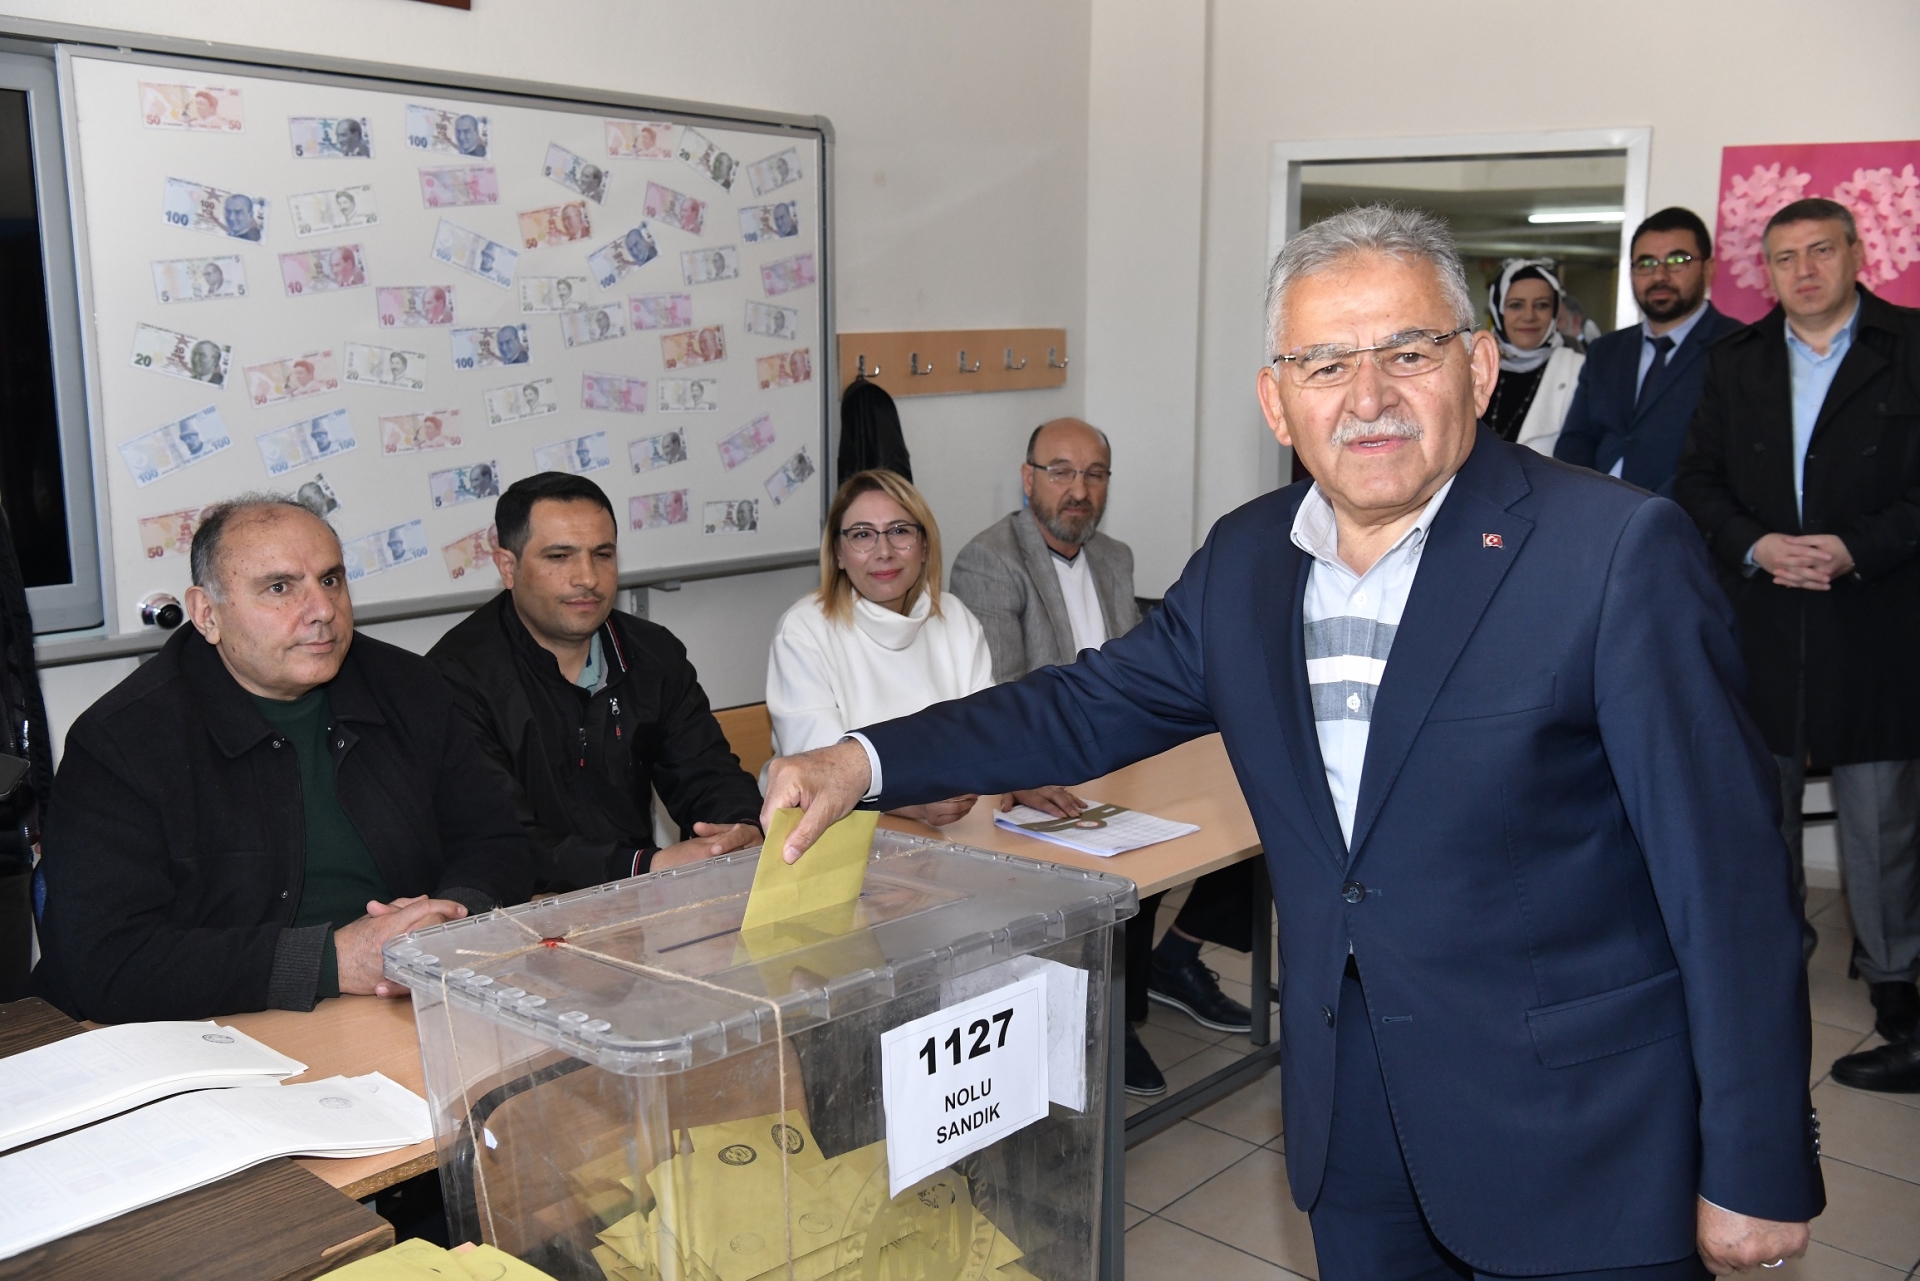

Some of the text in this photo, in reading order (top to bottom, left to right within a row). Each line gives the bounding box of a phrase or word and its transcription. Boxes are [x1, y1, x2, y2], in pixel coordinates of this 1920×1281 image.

[146, 114, 160, 125] 50
[228, 120, 242, 130] 50
[408, 134, 428, 148] 100
[296, 144, 303, 156] 5
[680, 148, 690, 162] 20
[201, 200, 214, 210] 100
[166, 210, 188, 226] 100
[366, 213, 377, 223] 20
[299, 224, 311, 234] 20
[526, 238, 538, 249] 50
[496, 274, 511, 287] 100
[600, 274, 616, 288] 100
[238, 284, 244, 295] 5
[288, 282, 302, 294] 10
[162, 291, 169, 302] 5
[523, 303, 534, 312] 20
[382, 314, 395, 326] 10
[134, 353, 152, 367] 20
[455, 358, 474, 368] 100
[347, 372, 358, 380] 20
[411, 380, 422, 389] 20
[202, 406, 216, 416] 100
[547, 403, 557, 413] 20
[491, 415, 502, 424] 20
[210, 436, 231, 450] 100
[338, 438, 356, 450] 100
[450, 436, 461, 446] 50
[385, 444, 397, 453] 50
[270, 462, 288, 474] 100
[634, 463, 640, 474] 5
[138, 469, 159, 483] 100
[434, 496, 442, 507] 5
[633, 520, 643, 530] 10
[705, 524, 716, 534] 20
[147, 546, 164, 558] 50
[412, 548, 428, 559] 100
[347, 569, 364, 580] 100
[452, 567, 465, 580] 50
[919, 1008, 1014, 1076] 1127
[945, 1078, 992, 1112] NOLU
[936, 1102, 1001, 1144] SANDIK
